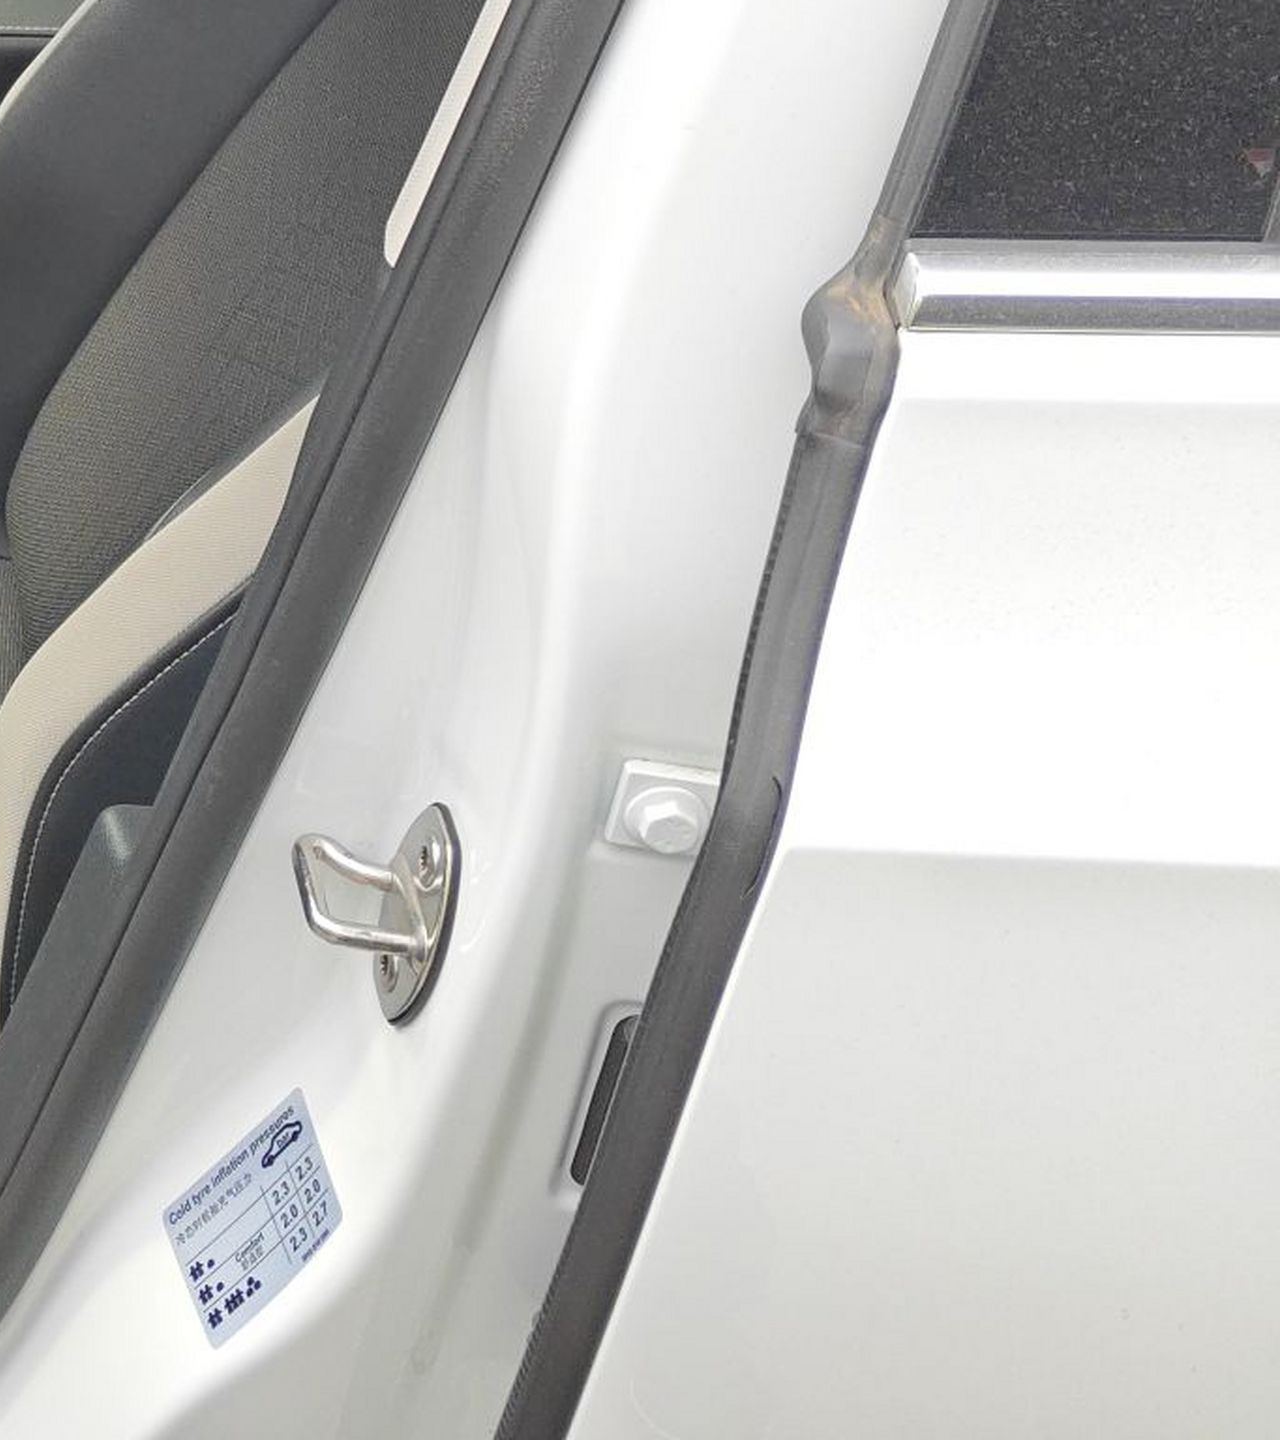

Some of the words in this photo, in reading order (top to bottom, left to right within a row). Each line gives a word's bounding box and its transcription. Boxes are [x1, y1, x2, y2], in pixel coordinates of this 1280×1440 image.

[169, 1200, 191, 1224] Cold
[192, 1185, 212, 1205] tyre
[210, 1150, 249, 1189] inflation
[248, 1106, 294, 1156] pressures
[272, 1180, 290, 1205] 2.3
[295, 1156, 313, 1181] 2.3
[280, 1203, 299, 1228] 2.0
[304, 1178, 321, 1204] 2.0
[290, 1226, 308, 1252] 2.3
[312, 1200, 329, 1227] 2.7
